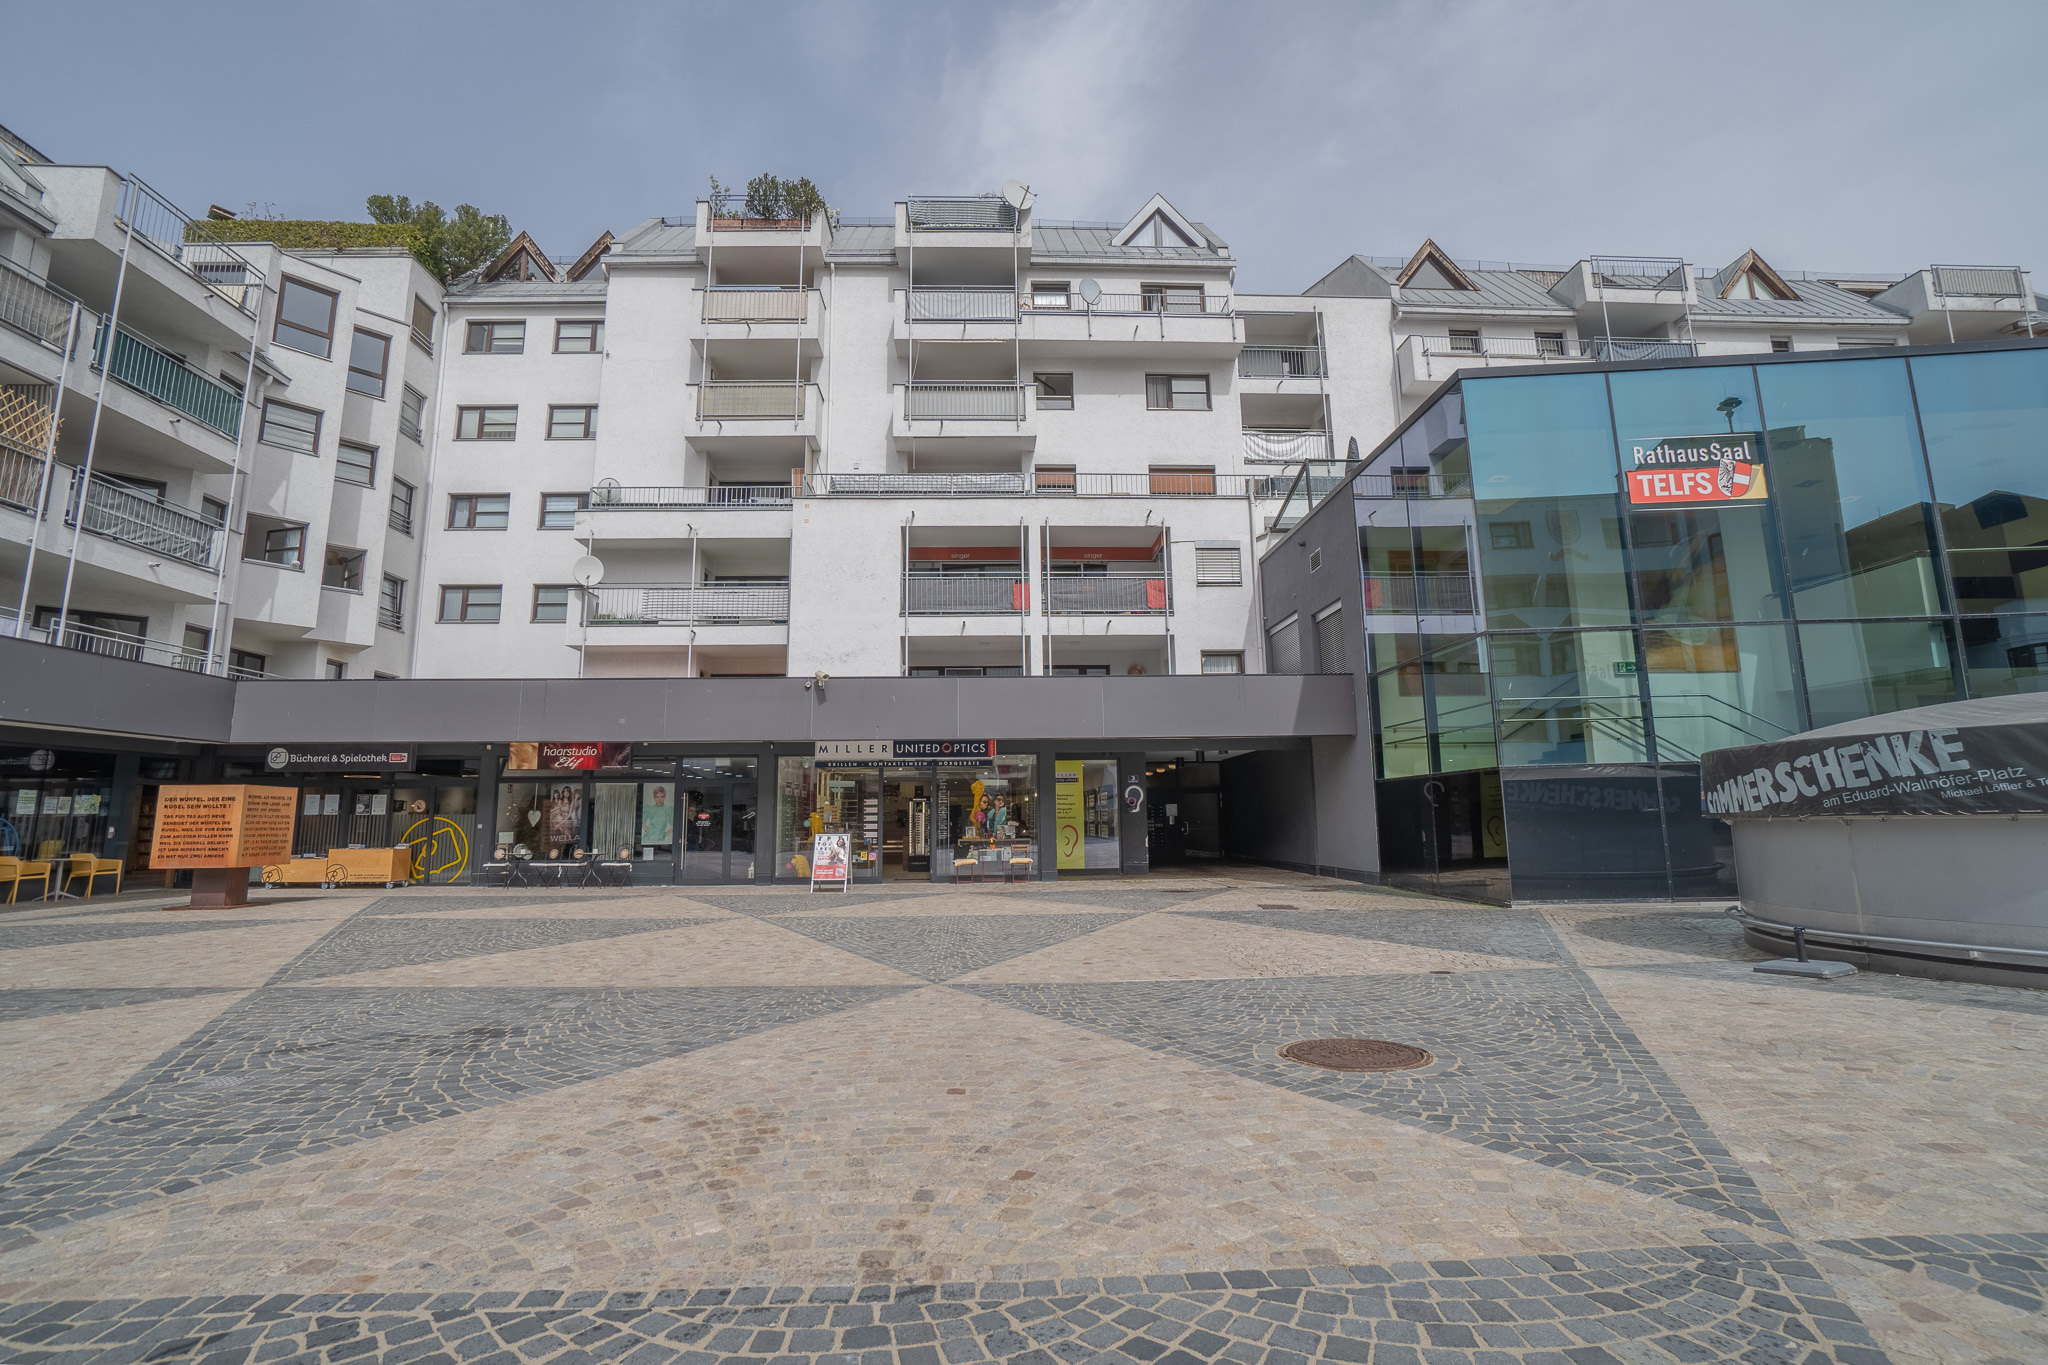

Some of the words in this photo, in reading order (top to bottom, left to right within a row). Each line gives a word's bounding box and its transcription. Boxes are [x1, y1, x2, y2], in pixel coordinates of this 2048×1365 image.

[1632, 441, 1752, 465] RathausSaal
[1636, 472, 1713, 497] TELFS
[543, 746, 598, 756] haarstudio
[818, 744, 888, 754] MILLER
[290, 754, 330, 762] Bücherei
[340, 754, 388, 764] Spielothek
[554, 756, 584, 769] Elif
[1706, 728, 1971, 814] SOMMERSCHENKE
[1823, 796, 1841, 808] am
[1842, 765, 2027, 804] Eduard-Wallnöfer-Platz
[1940, 786, 1984, 799] Michael
[1985, 782, 2023, 793] Löffler
[2026, 780, 2036, 788] &
